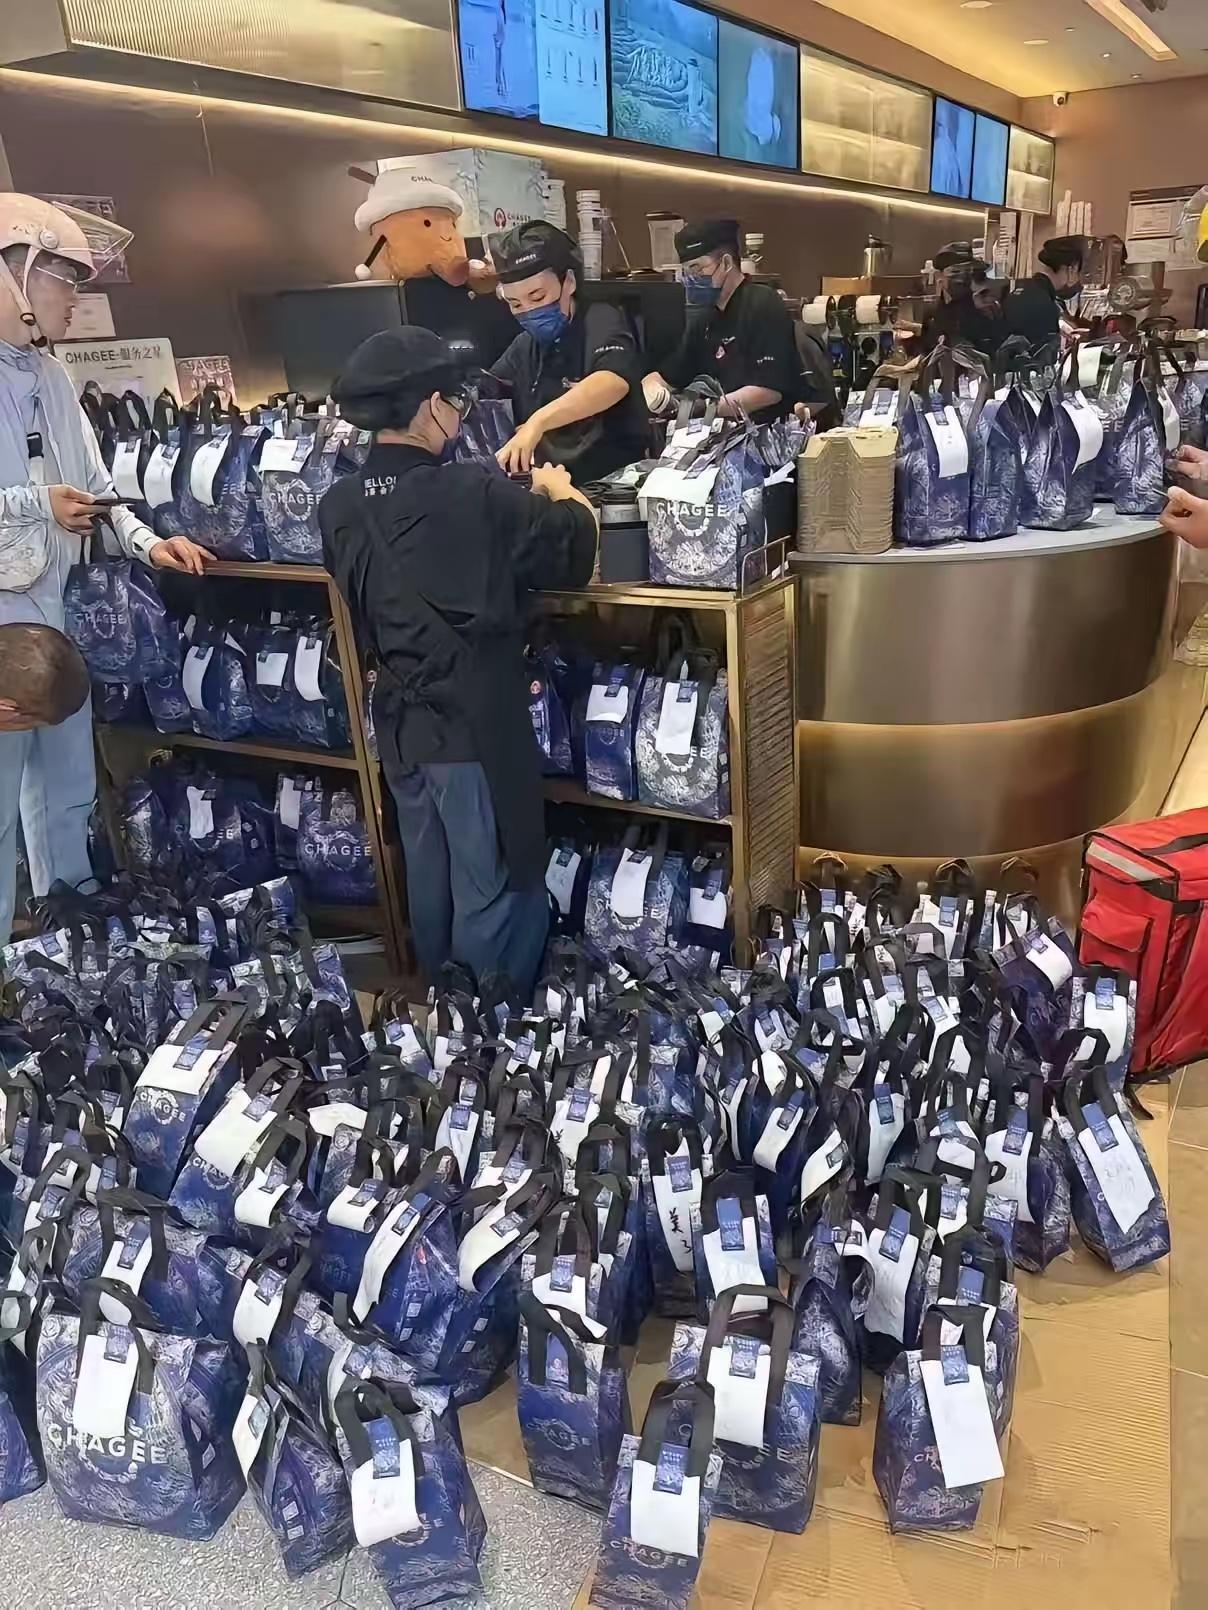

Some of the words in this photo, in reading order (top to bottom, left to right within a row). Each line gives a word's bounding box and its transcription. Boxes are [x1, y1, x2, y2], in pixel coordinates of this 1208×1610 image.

[656, 501, 728, 517] CHAGEE
[304, 842, 372, 857] CHAGEE
[46, 1422, 169, 1465] CHAGEE
[609, 1538, 688, 1568] CHAGEE
